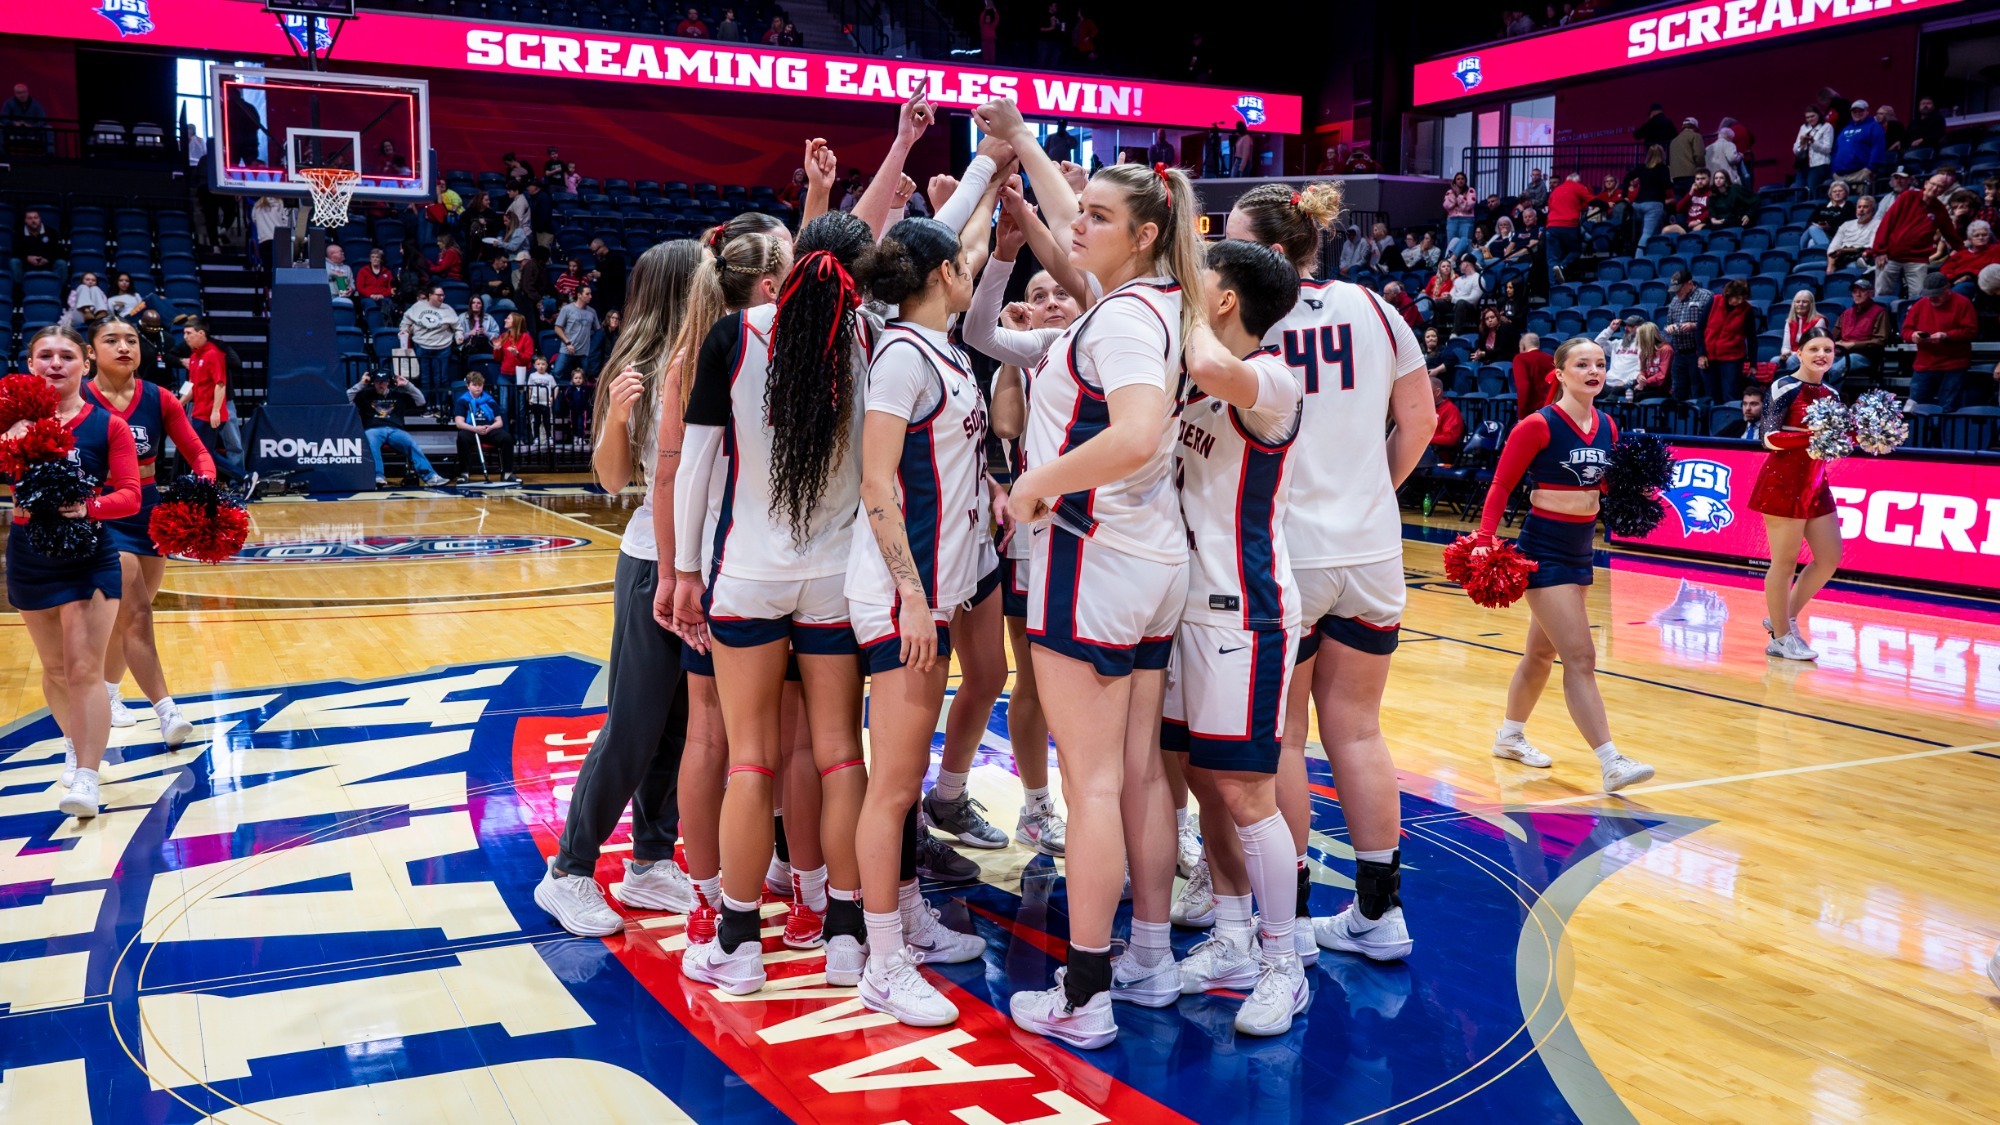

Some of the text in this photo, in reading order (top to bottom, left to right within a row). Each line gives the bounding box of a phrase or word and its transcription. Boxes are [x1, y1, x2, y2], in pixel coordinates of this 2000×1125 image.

[466, 29, 1143, 116] SCREAMING EAGLES WIN!
[1457, 58, 1481, 72] USI
[1238, 96, 1263, 110] USI
[1283, 323, 1354, 395] 44
[260, 438, 362, 458] ROMAIN
[297, 456, 362, 465] CROSS POINTE
[1571, 450, 1607, 465] USI
[1674, 462, 1730, 494] USI
[1228, 599, 1235, 607] M
